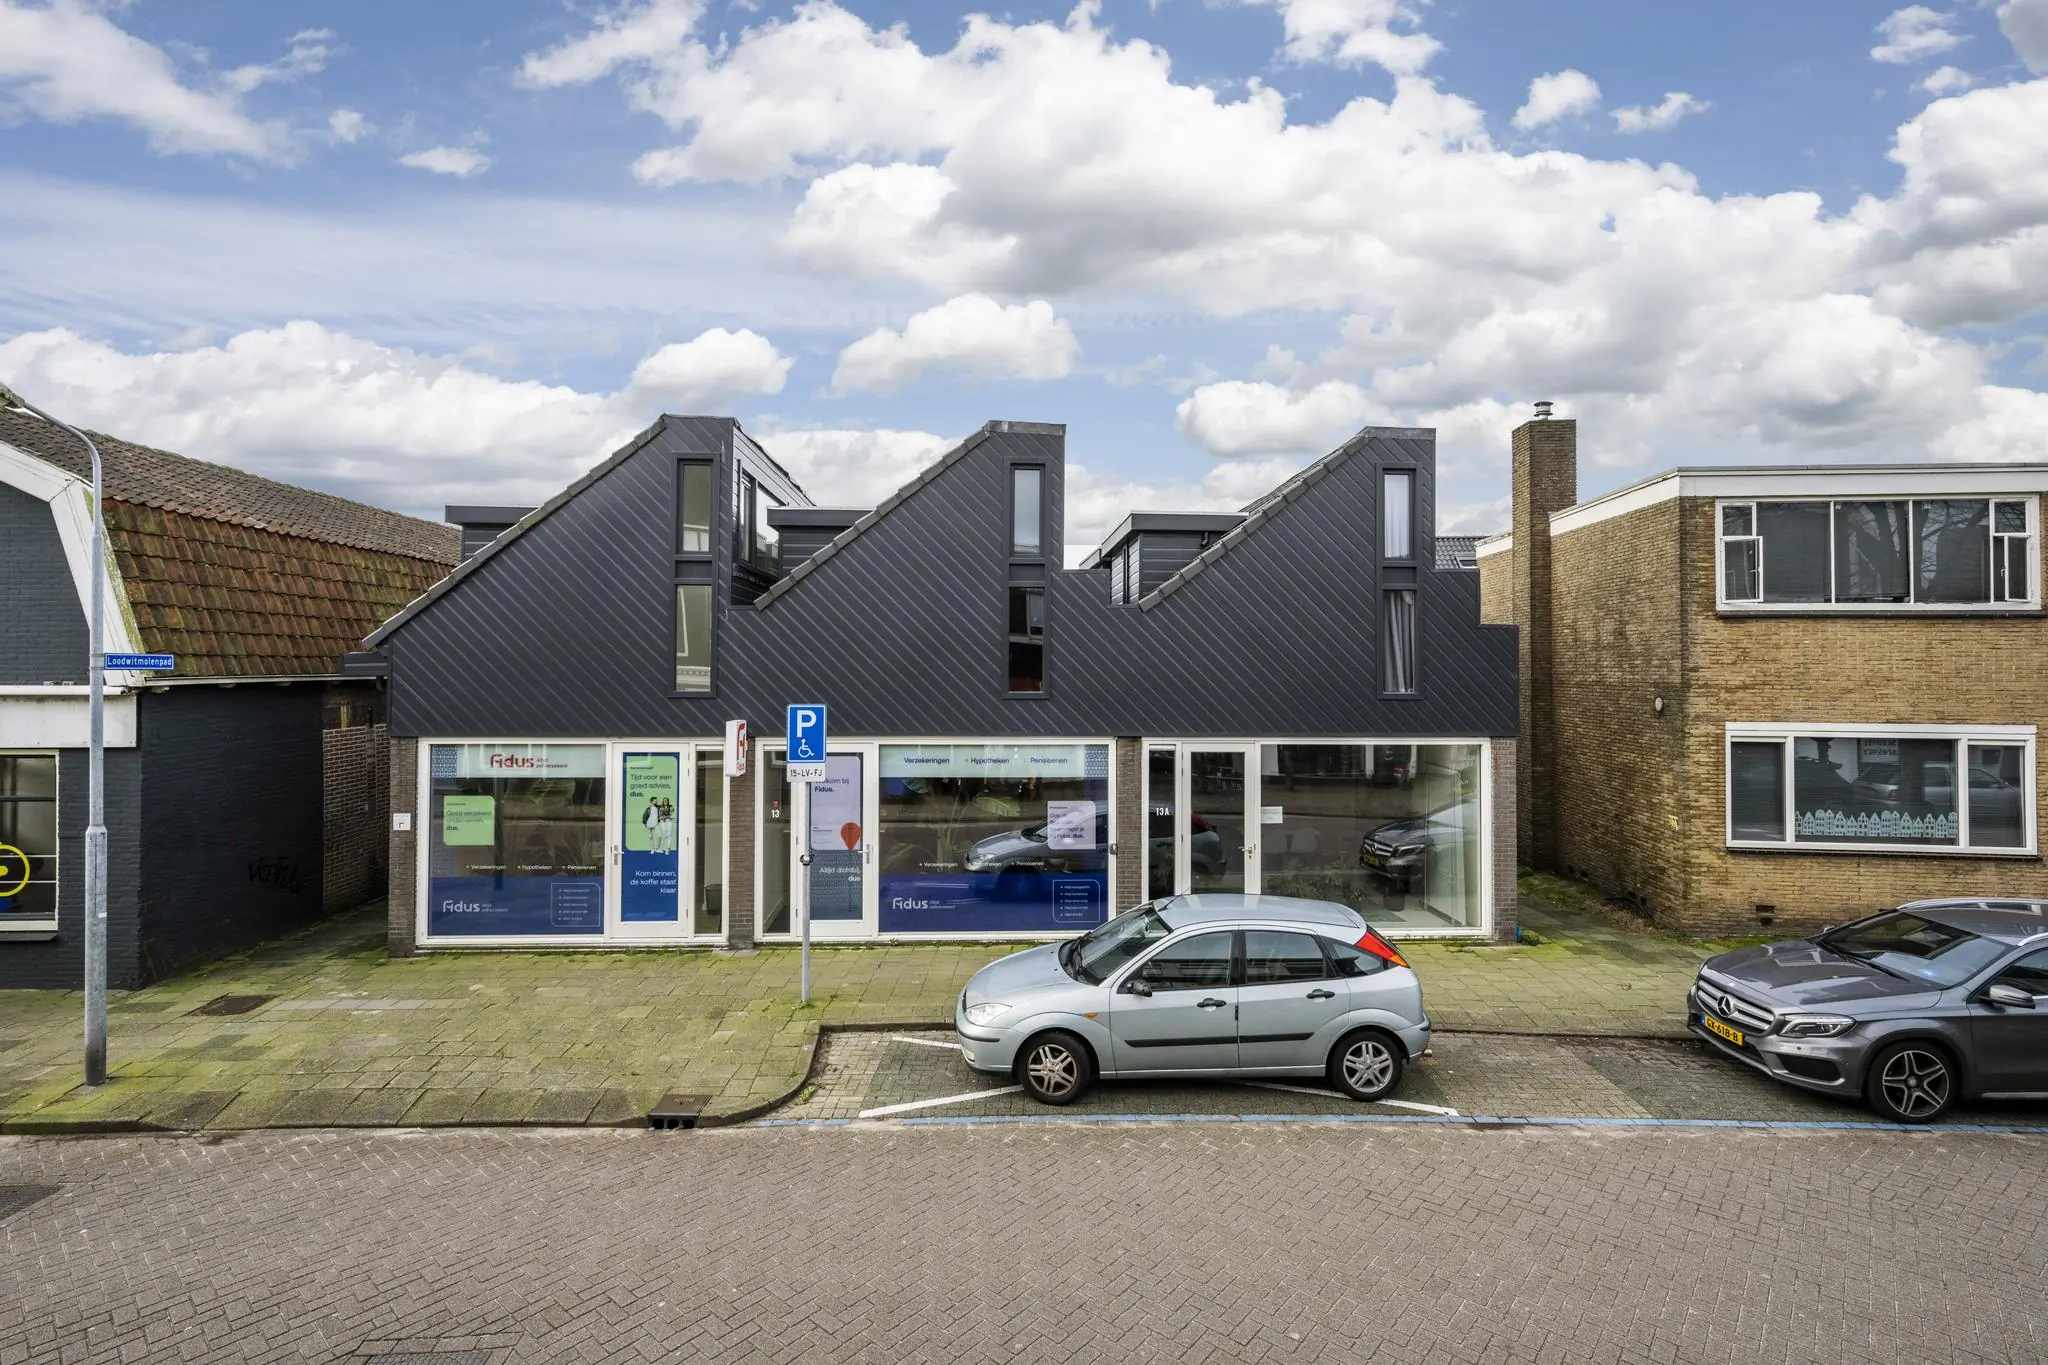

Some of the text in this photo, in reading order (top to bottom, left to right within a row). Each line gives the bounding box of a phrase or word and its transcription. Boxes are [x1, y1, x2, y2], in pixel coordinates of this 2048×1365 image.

[107, 656, 172, 667] Loodwitmolenpad
[796, 709, 817, 738] P
[903, 756, 1068, 765] Verzekeringen Hypotheken Pensioenen
[630, 782, 648, 790] goed
[771, 809, 780, 818] 13
[1155, 807, 1170, 816] 13A
[635, 869, 677, 877] Kom binnen,
[630, 878, 640, 886] de
[442, 899, 481, 913] Fidus
[892, 897, 929, 910] Fidus
[1706, 1017, 1739, 1042] GX-618-B
